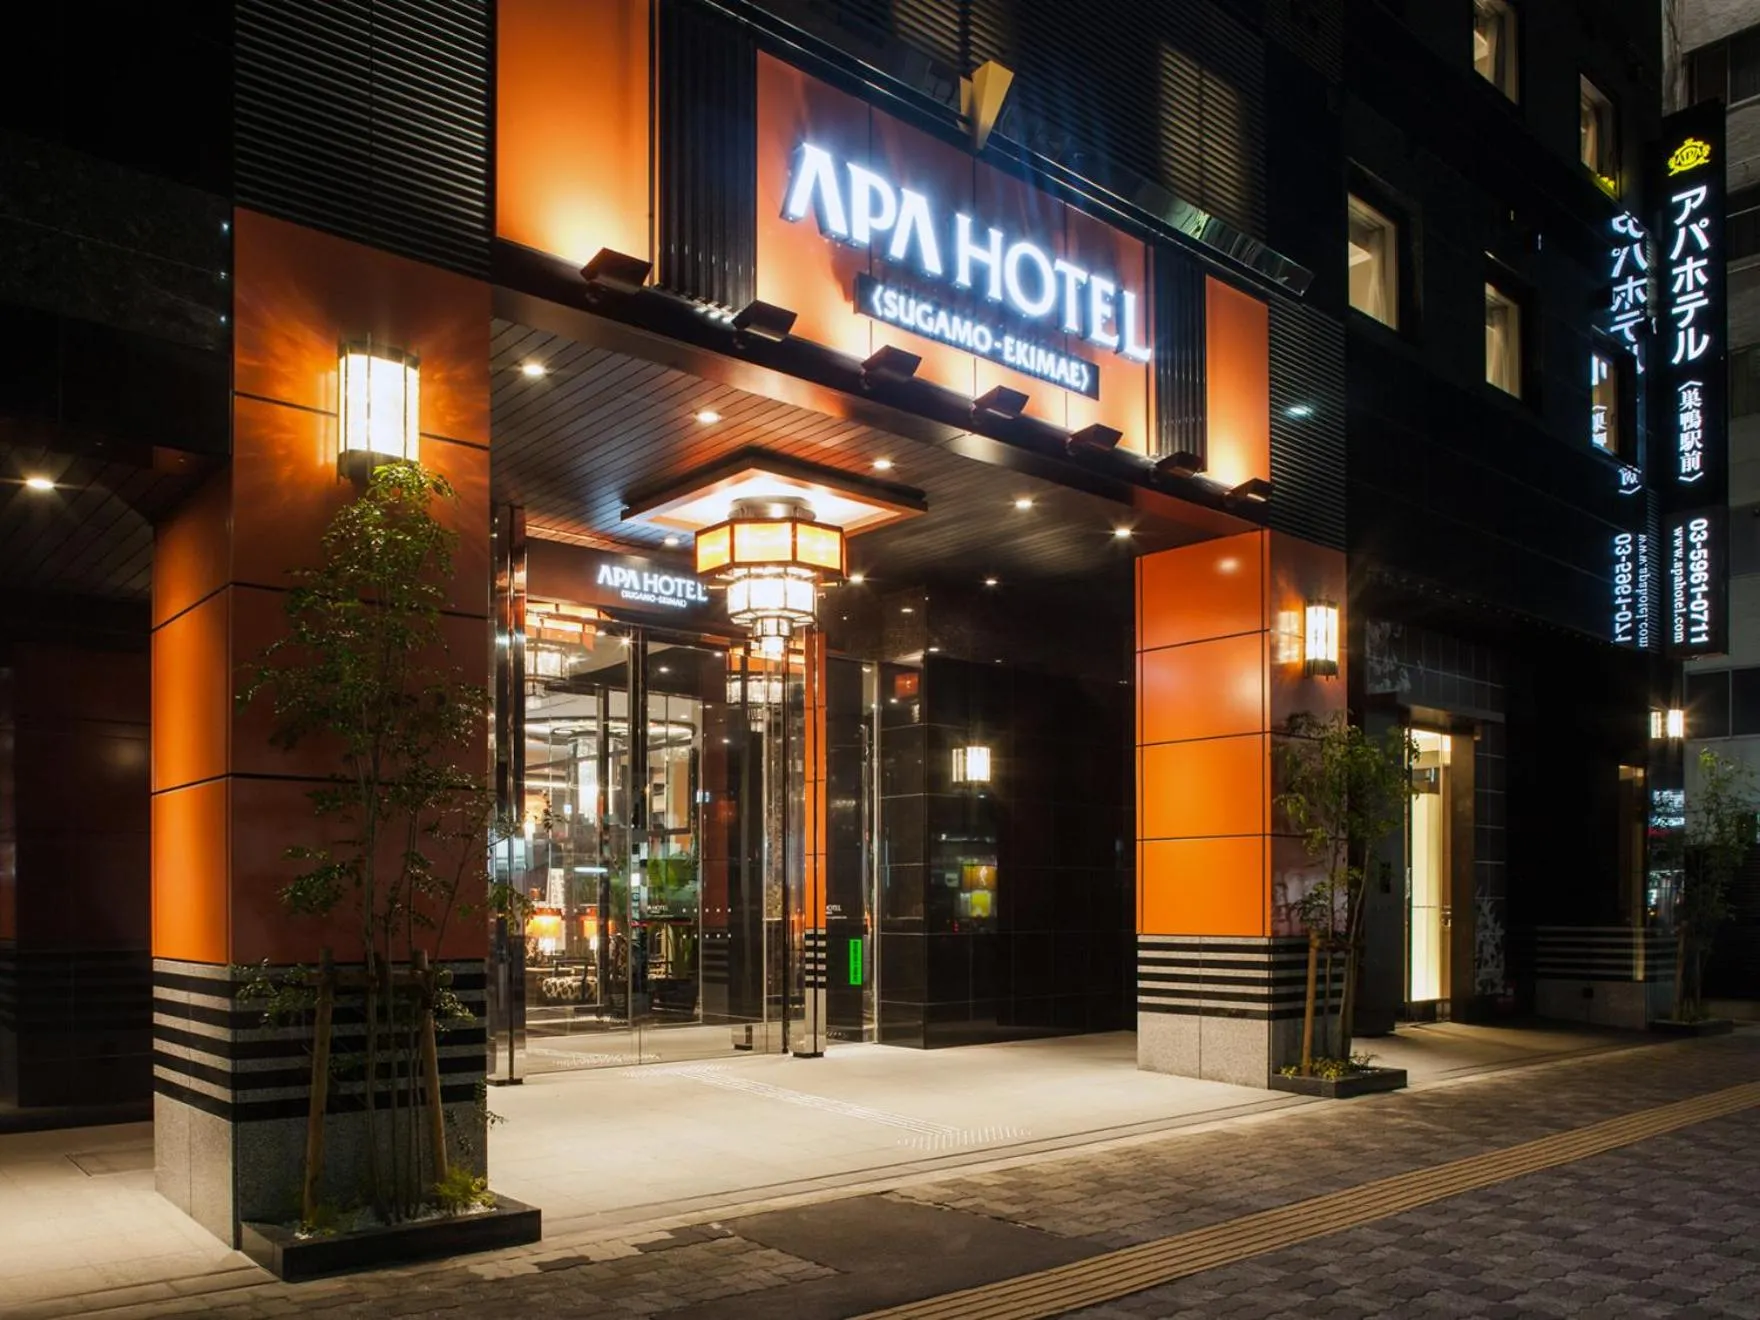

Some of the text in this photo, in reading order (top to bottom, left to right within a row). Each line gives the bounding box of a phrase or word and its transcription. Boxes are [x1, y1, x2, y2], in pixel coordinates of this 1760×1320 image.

[781, 142, 1151, 361] APA HOTEL
[1670, 185, 1710, 364] アパホテル
[597, 565, 708, 602] APA HOTEL
[1670, 525, 1688, 645] www.apahotel.com
[1689, 518, 1709, 644] 03-5961-0711
